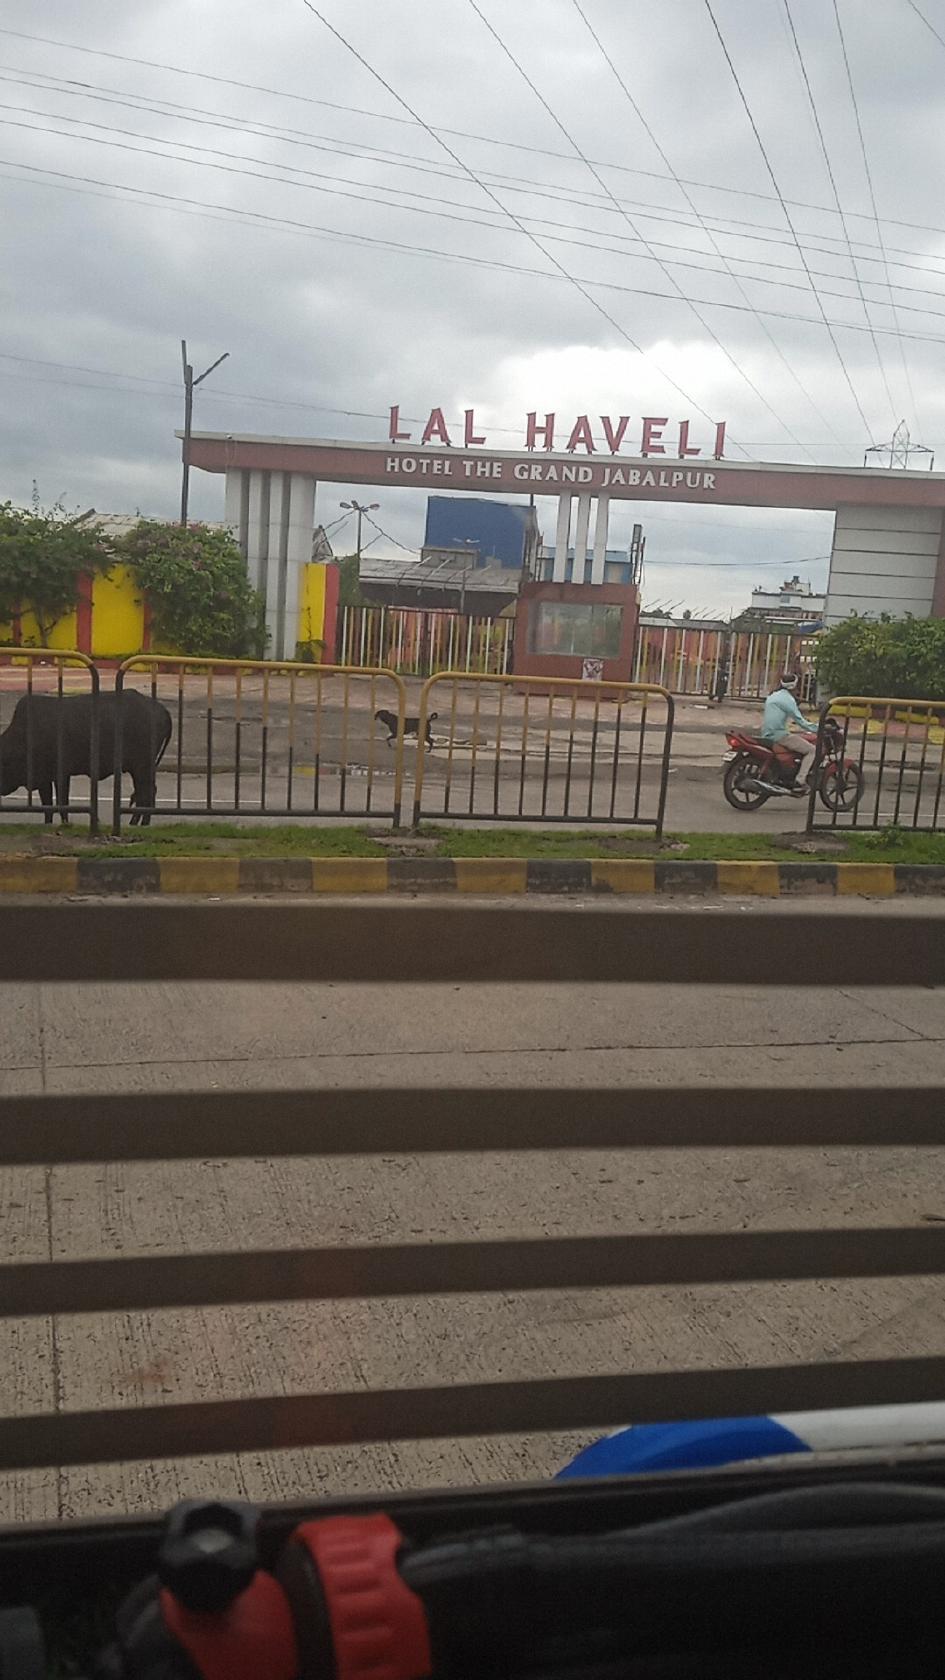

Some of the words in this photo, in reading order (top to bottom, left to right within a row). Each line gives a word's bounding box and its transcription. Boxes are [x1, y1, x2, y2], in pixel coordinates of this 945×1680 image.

[389, 405, 486, 446] LAL
[526, 411, 726, 458] HAVELI
[385, 456, 453, 477] HOTEL
[463, 460, 502, 479] THE
[513, 463, 593, 484] GRAND
[601, 467, 717, 490] JABALPUR
